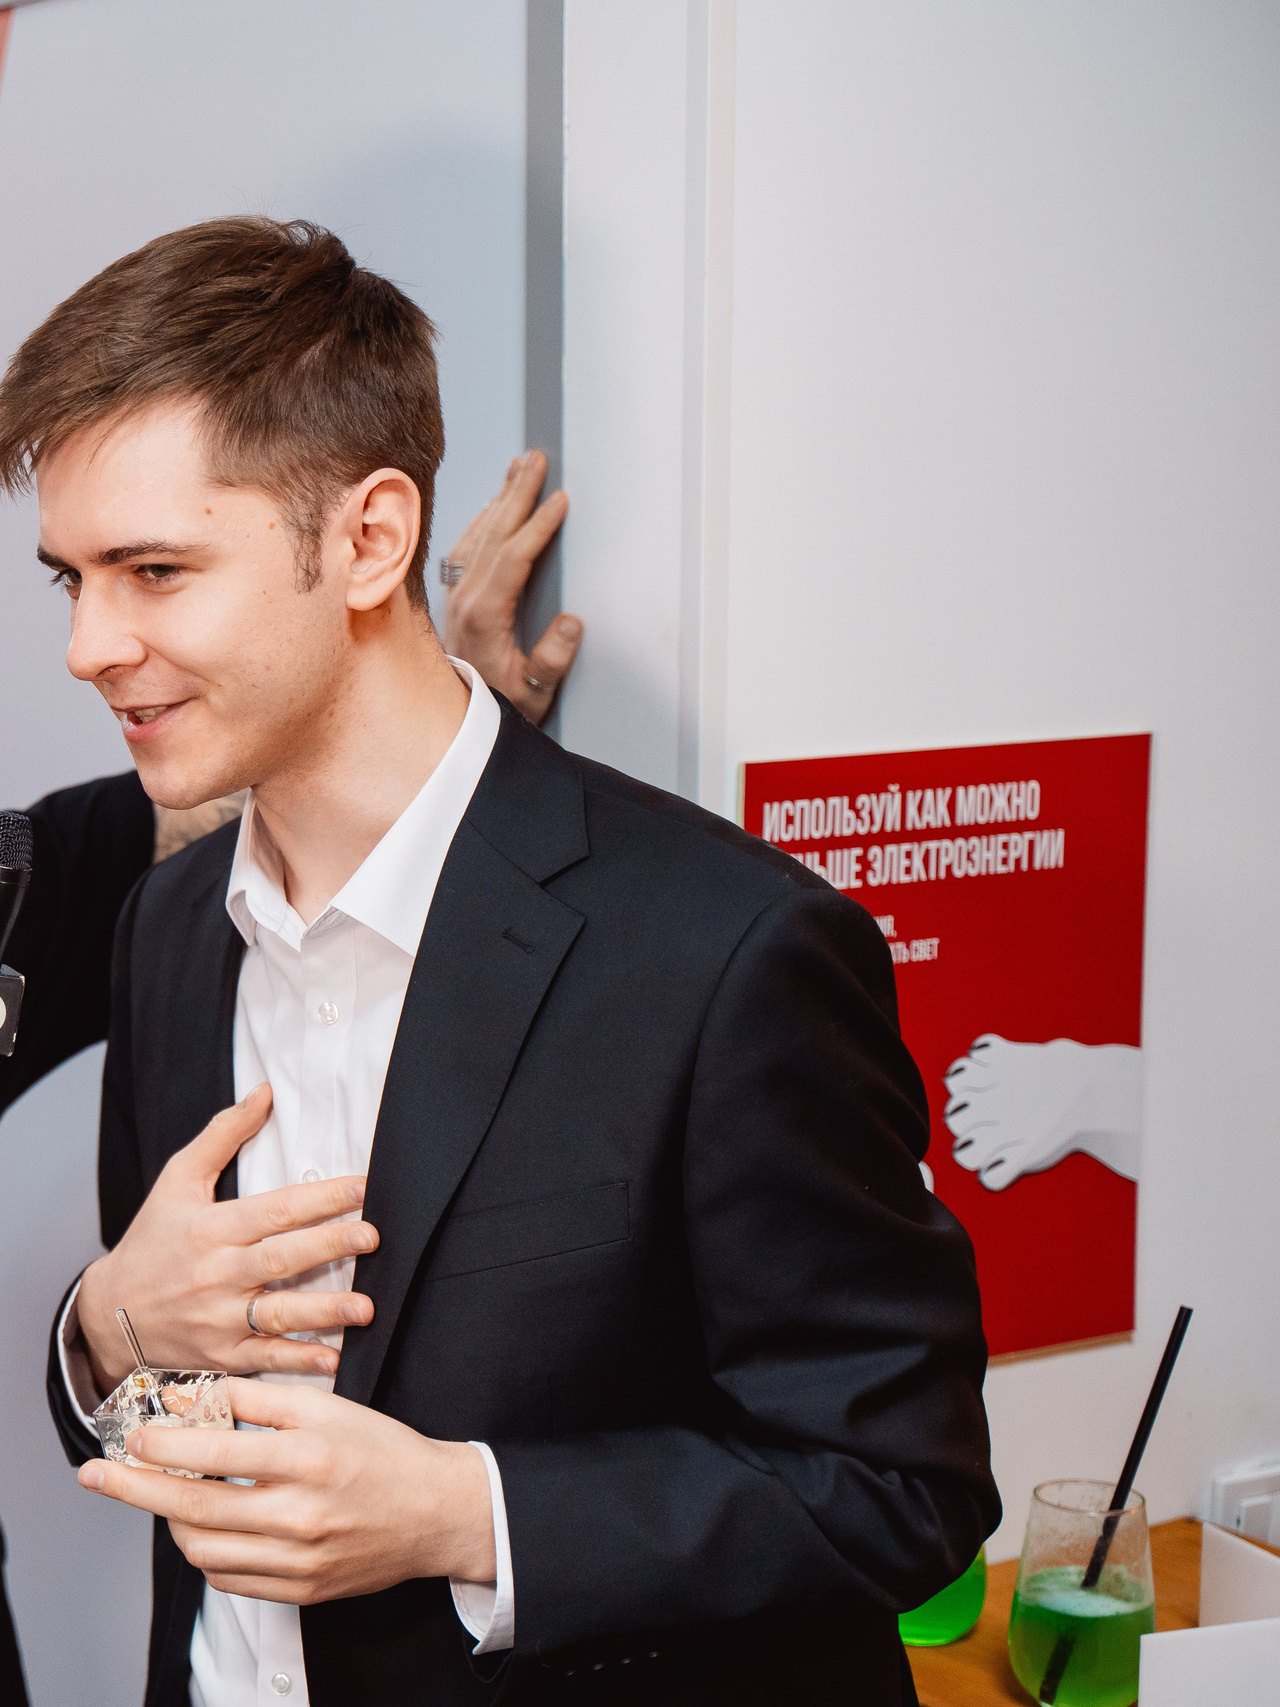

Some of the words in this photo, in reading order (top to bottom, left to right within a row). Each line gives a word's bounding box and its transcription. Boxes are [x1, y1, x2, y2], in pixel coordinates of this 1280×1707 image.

[763, 784, 901, 842] ИСПОЛЬЗУЙ
[905, 787, 952, 831] КАК
[955, 780, 1041, 826] МОЖНО
[790, 847, 863, 889] ЬШЕ
[867, 828, 1065, 887] ЭЛЕКТРОЭНЕРГИИ
[910, 937, 939, 962] СВЕТ
